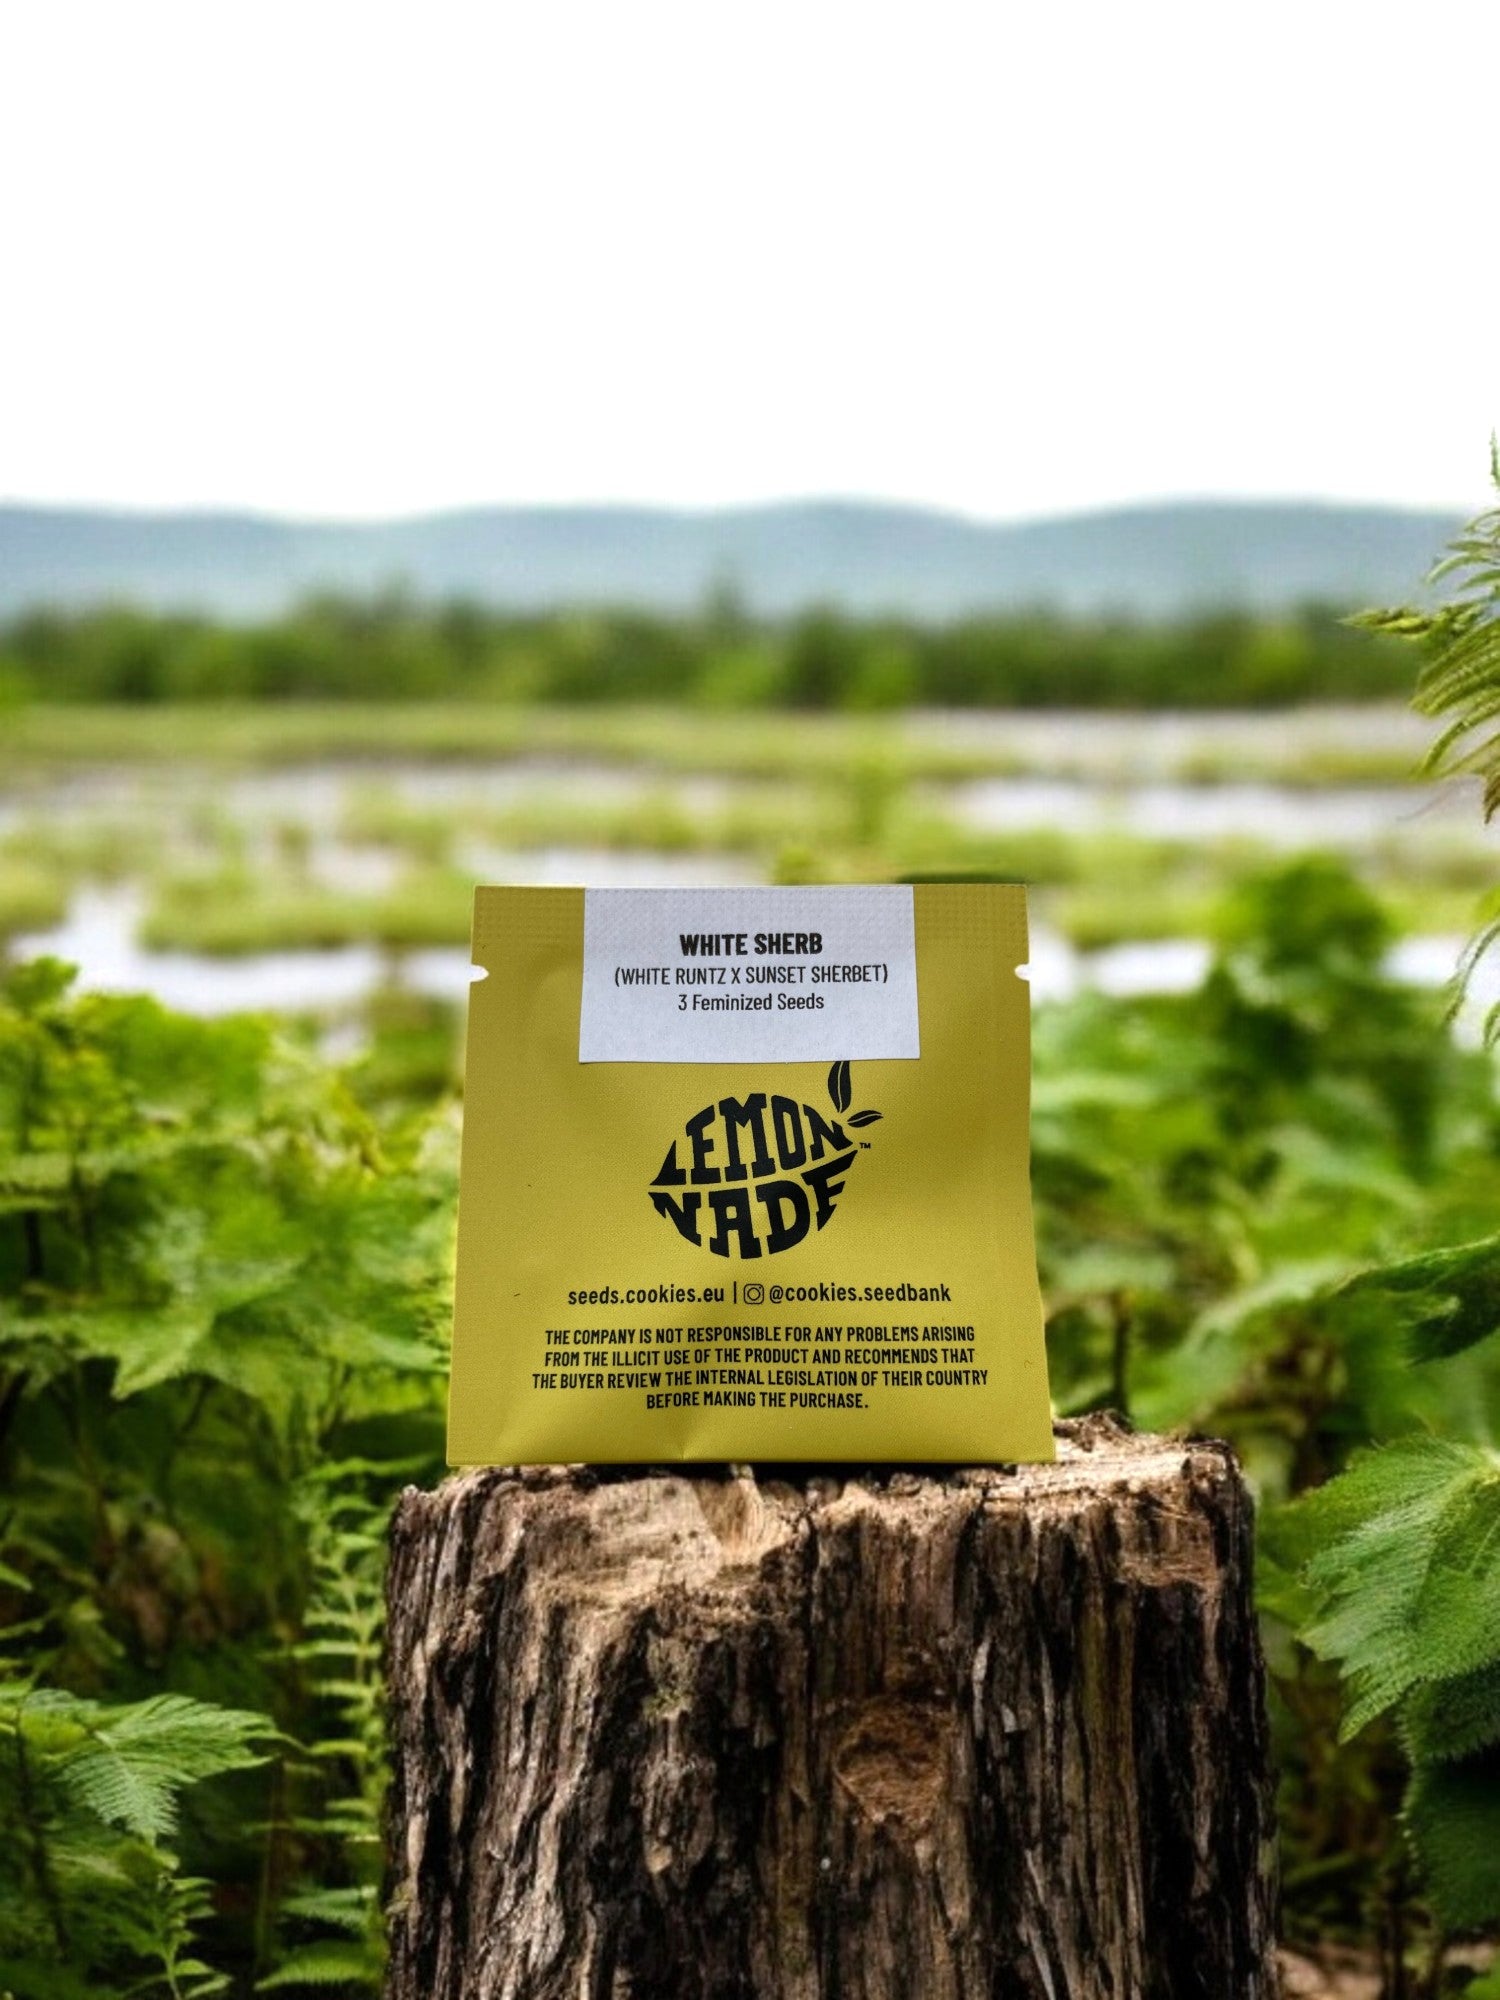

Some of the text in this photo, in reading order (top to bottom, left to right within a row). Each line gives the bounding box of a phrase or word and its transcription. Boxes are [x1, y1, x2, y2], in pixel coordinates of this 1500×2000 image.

[679, 933, 822, 956] WHITE SHERB
[615, 964, 888, 987] (WHITE RUNTZ X SUNSET SHERBET)
[678, 993, 824, 1010] 3 Feminized Seeds
[650, 1093, 853, 1186] LEMON
[568, 1284, 724, 1305] seeds.cookies.eu
[769, 1282, 951, 1304] @cookies.seedbank
[545, 1326, 974, 1345] THE COMPANY IS NOT RESPONSIBLE FOR ANY PROBLEMS ARISING
[545, 1348, 975, 1366] FROM THE ILLICIT USE OF THE PRODUCT AND RECOMMENDS THAT
[532, 1370, 988, 1389] THE BUYER REVIEW THE INTERNAL LEGISLATION OF THEIR COUNTRY
[647, 1391, 868, 1409] BEFORE MAKING THE PURCHASE.
